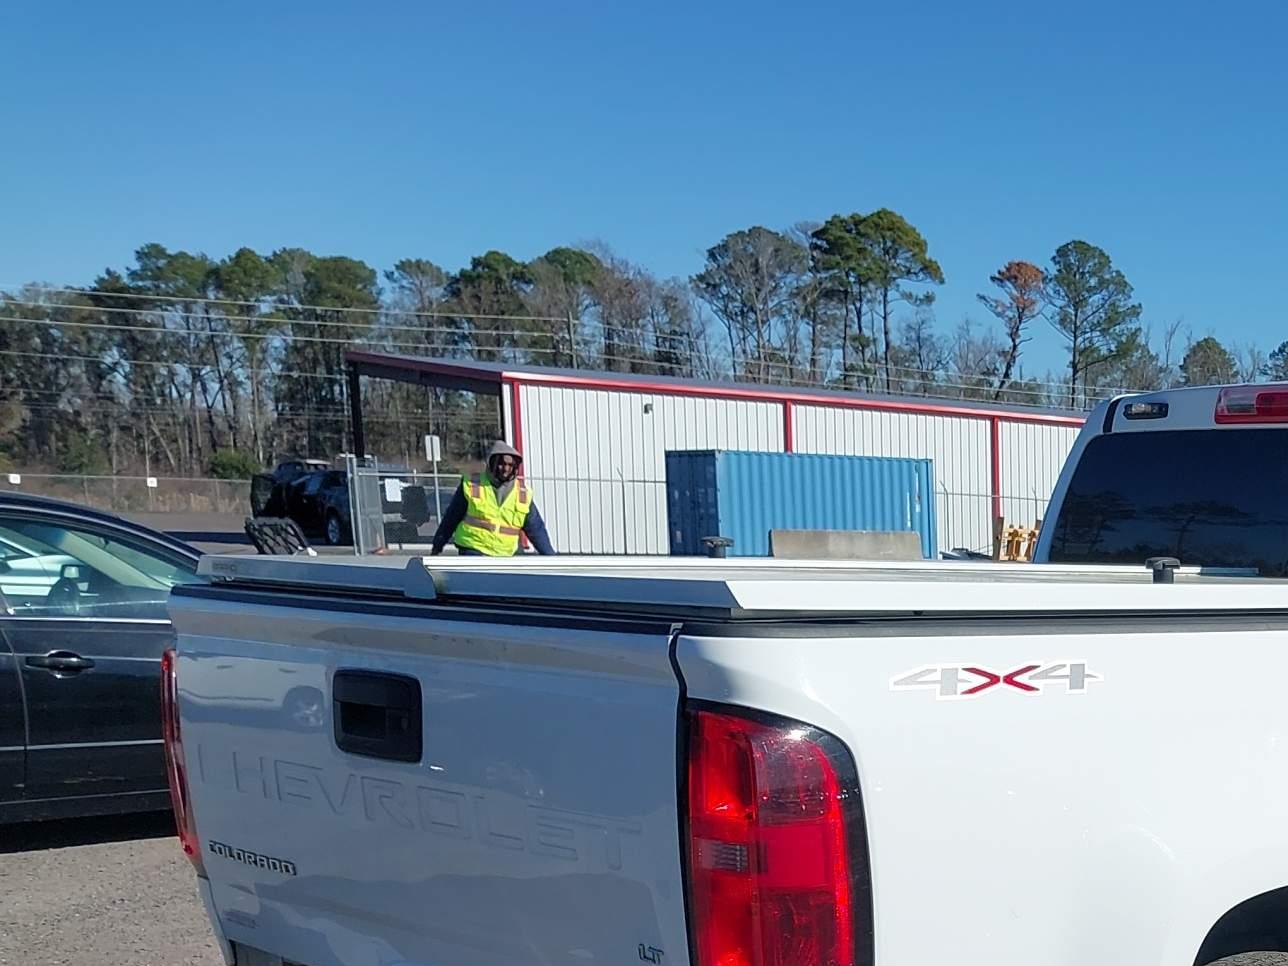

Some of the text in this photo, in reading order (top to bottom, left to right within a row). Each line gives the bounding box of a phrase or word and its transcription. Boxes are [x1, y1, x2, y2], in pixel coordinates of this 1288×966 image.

[197, 743, 643, 871] HEVROLET
[208, 839, 297, 877] COLORADO
[638, 943, 665, 966] LT
